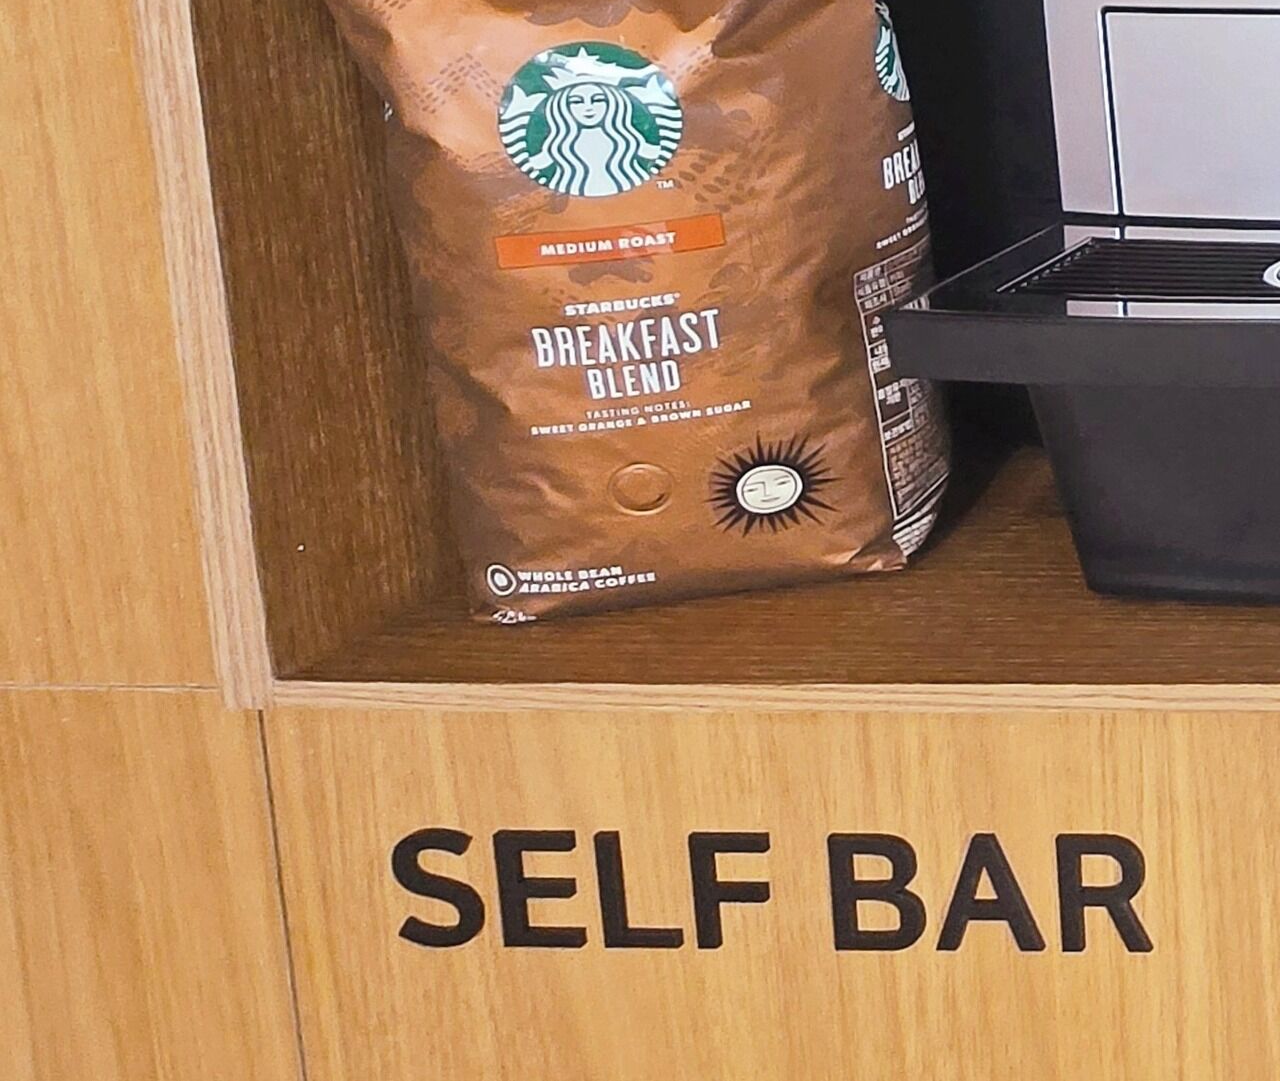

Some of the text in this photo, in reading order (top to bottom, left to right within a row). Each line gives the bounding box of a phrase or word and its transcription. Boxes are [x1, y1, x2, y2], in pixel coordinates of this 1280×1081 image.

[540, 231, 677, 257] MEDIUM ROAST
[531, 308, 722, 369] BREAKFAST
[586, 360, 682, 400] BLEND
[530, 423, 574, 436] SWEET
[578, 419, 633, 433] ORANGE
[651, 409, 702, 424] BROWN
[706, 400, 752, 417] SUGAR
[585, 406, 640, 420] TASTING
[517, 565, 623, 582] WHOLE BEAN
[518, 572, 657, 594] ARABICA COFFEE
[390, 827, 1155, 953] SELF BAR
